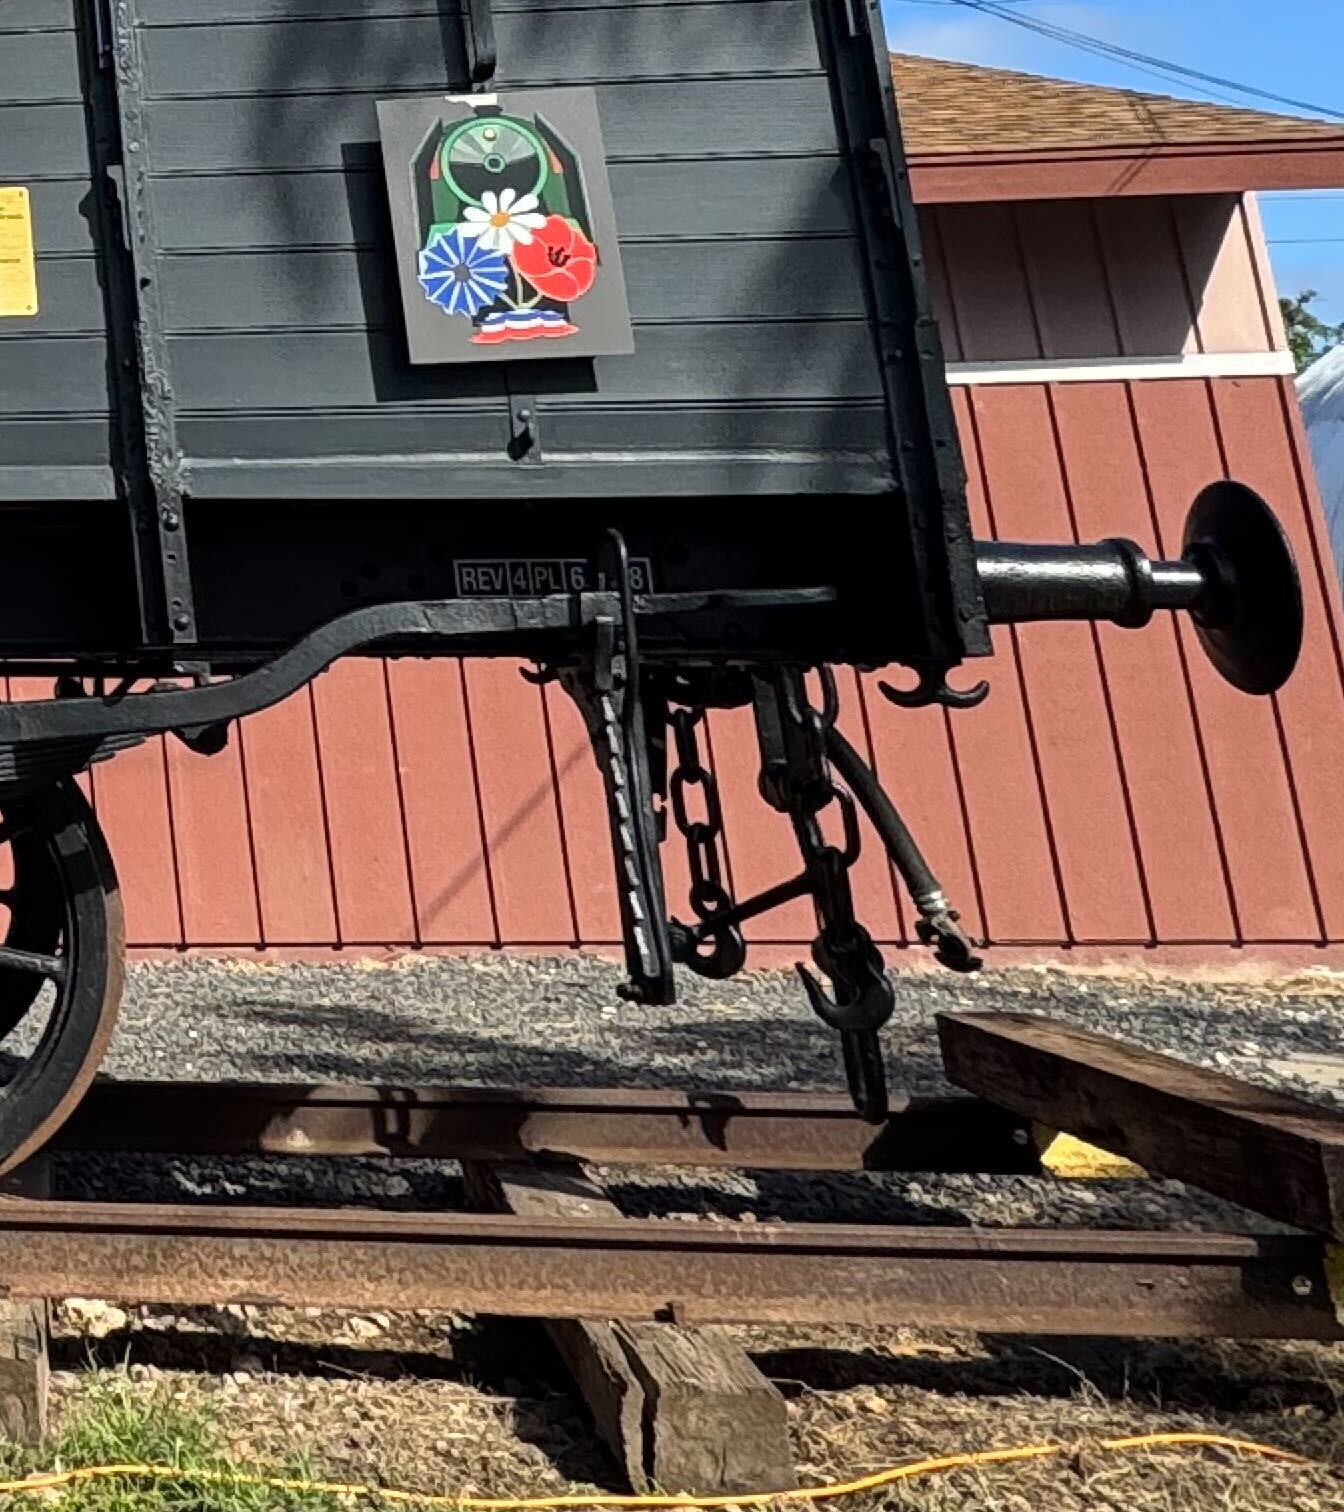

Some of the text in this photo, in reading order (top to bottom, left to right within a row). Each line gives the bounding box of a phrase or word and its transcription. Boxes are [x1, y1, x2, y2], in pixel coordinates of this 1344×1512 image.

[462, 566, 503, 592] REV
[513, 566, 527, 590] 4
[534, 566, 562, 590] PL
